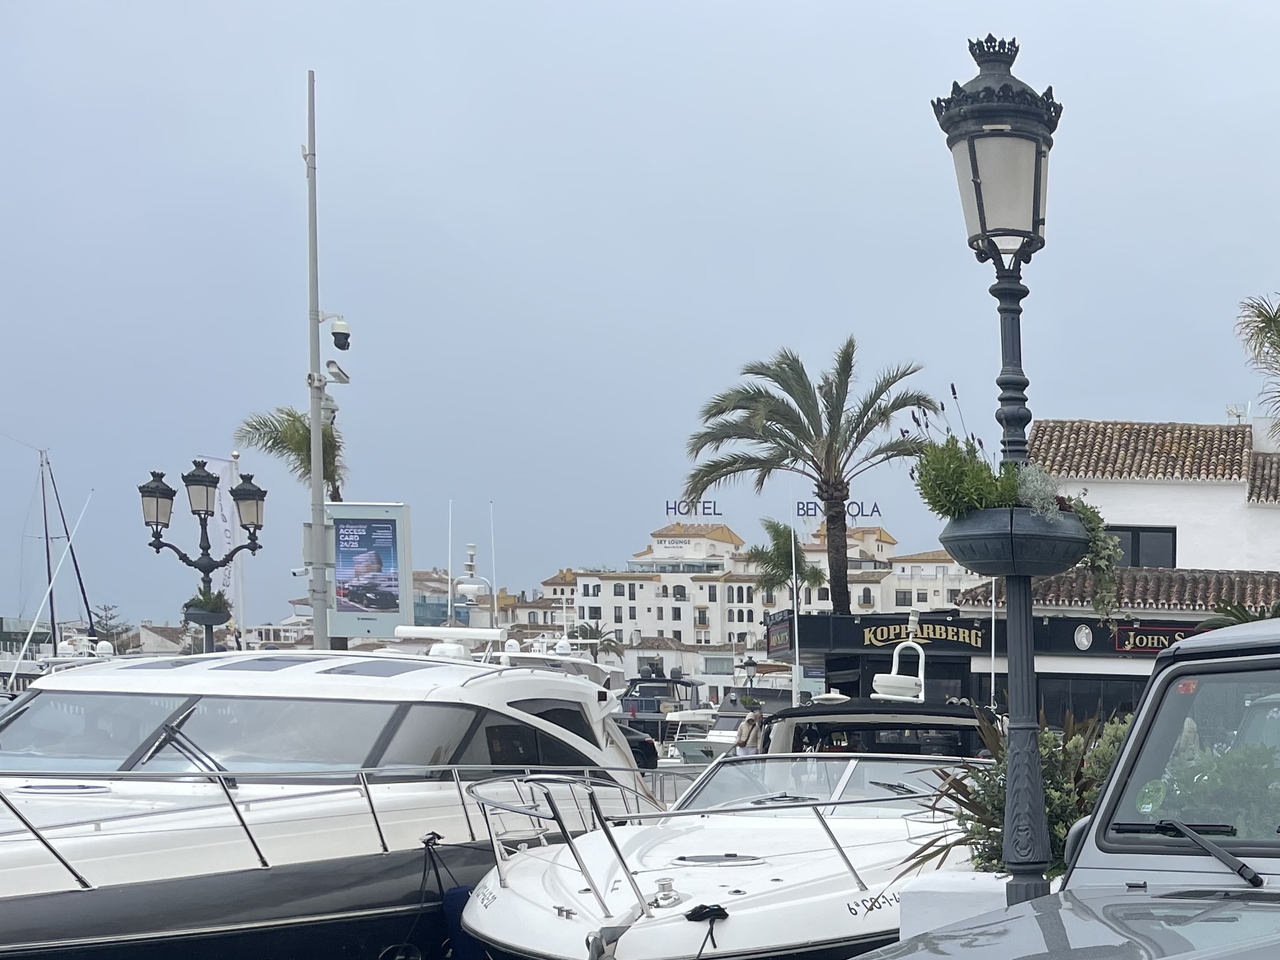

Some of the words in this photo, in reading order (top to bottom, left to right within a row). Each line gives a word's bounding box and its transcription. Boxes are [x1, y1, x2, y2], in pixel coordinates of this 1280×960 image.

[666, 500, 722, 516] HOTEL
[797, 501, 882, 517] BENOLA
[863, 623, 982, 648] KOPPARBERG
